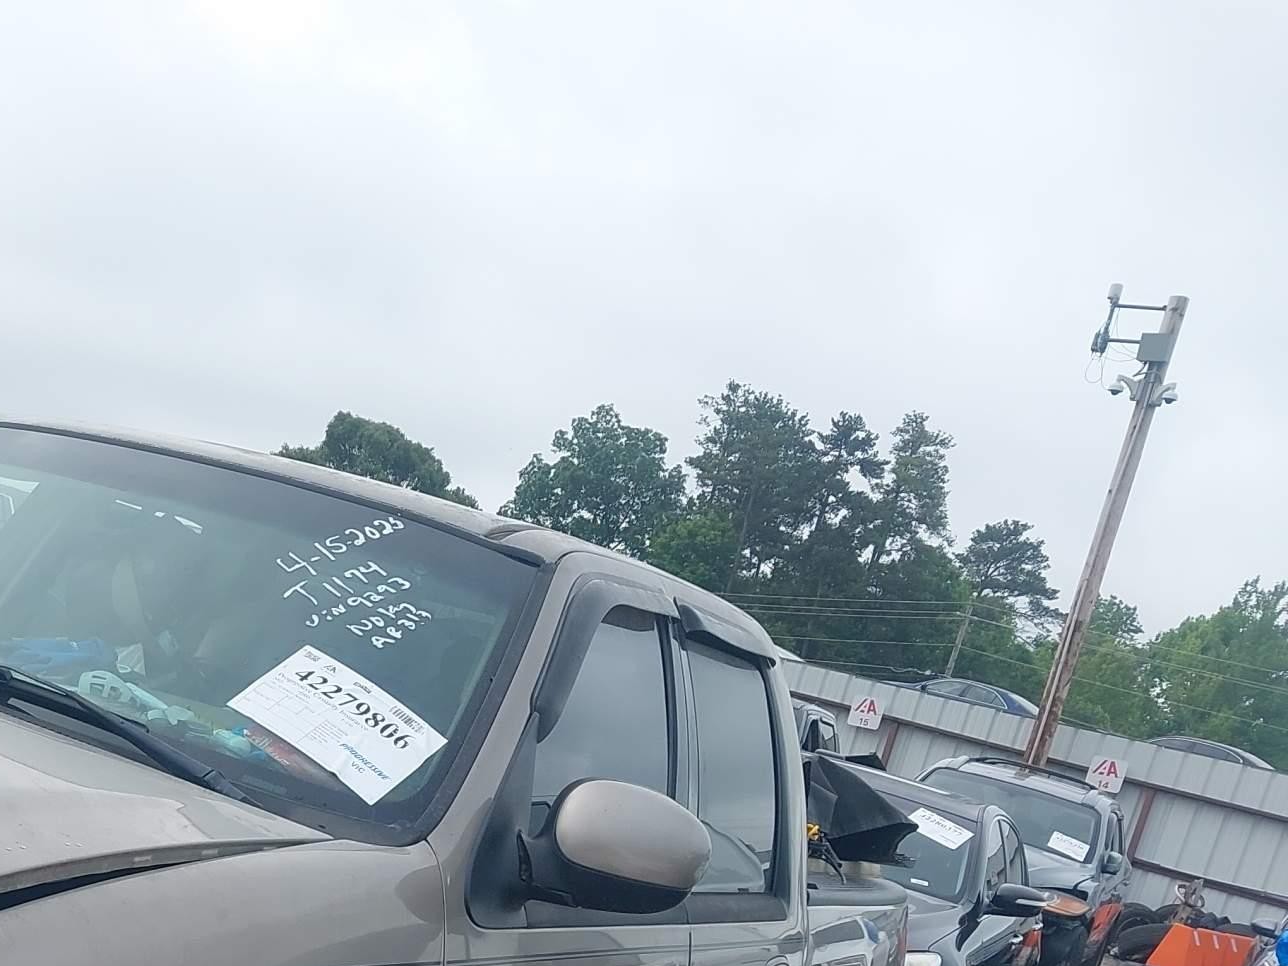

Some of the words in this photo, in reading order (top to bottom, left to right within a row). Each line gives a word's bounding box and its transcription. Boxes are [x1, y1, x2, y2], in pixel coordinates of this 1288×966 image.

[295, 670, 416, 749] 42279806
[859, 718, 870, 726] 15
[1098, 781, 1109, 789] 14
